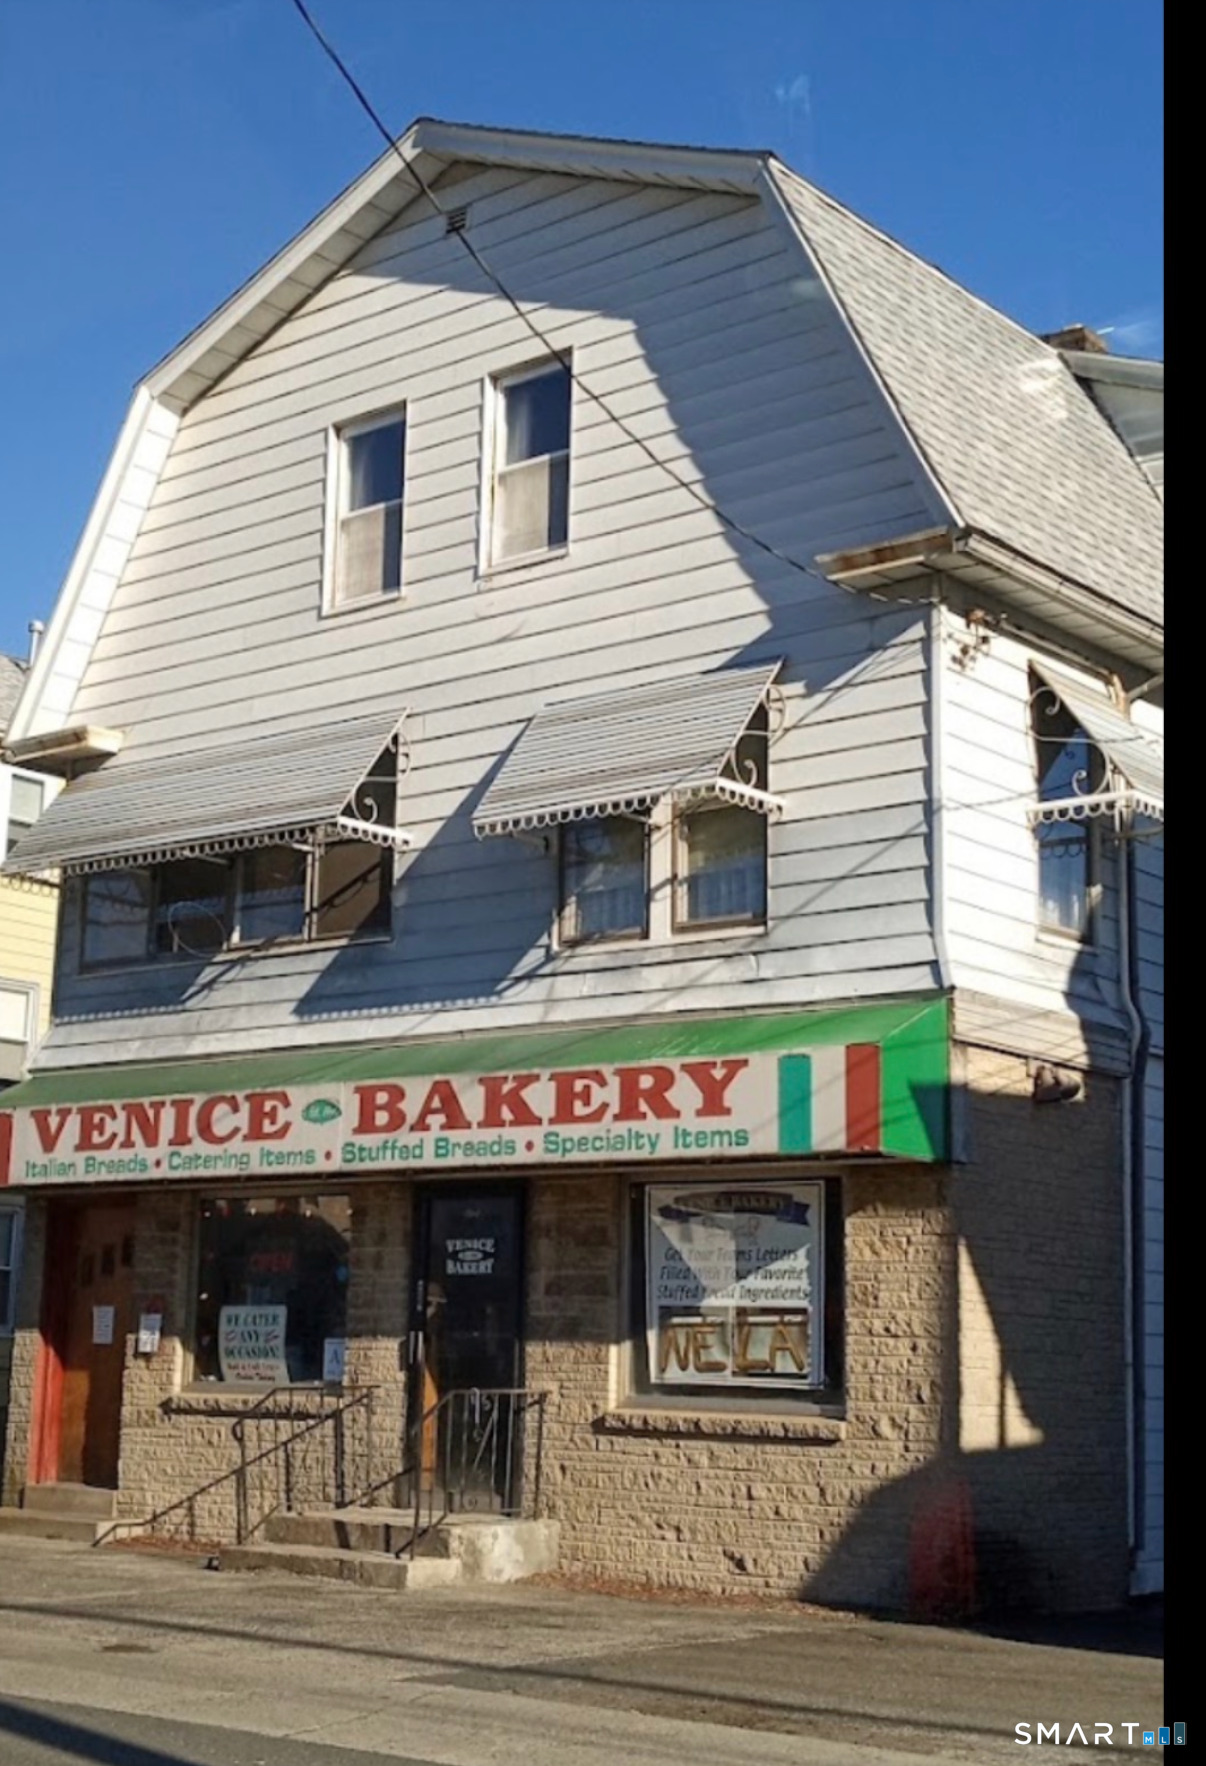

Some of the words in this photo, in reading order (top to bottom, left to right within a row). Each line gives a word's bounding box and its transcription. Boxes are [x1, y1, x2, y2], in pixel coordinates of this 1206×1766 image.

[30, 1090, 293, 1154] VENICE
[352, 1059, 749, 1136] BAKERY
[25, 1159, 76, 1178] Italian
[84, 1154, 149, 1175] Breads
[167, 1150, 250, 1173] Catering
[259, 1146, 316, 1167] Items
[341, 1135, 424, 1163] Stuffed
[434, 1134, 516, 1158] Breads
[543, 1128, 661, 1156] Specialty
[673, 1125, 750, 1151] Items
[446, 1238, 495, 1253] VENICE
[756, 1247, 798, 1261] Letters
[446, 1258, 494, 1275] BAKERY
[660, 1265, 690, 1280] Filled
[754, 1263, 805, 1280] Favorite
[657, 1284, 699, 1301] Stuffed
[739, 1284, 810, 1302] Ingredients
[243, 1313, 280, 1327] CATER
